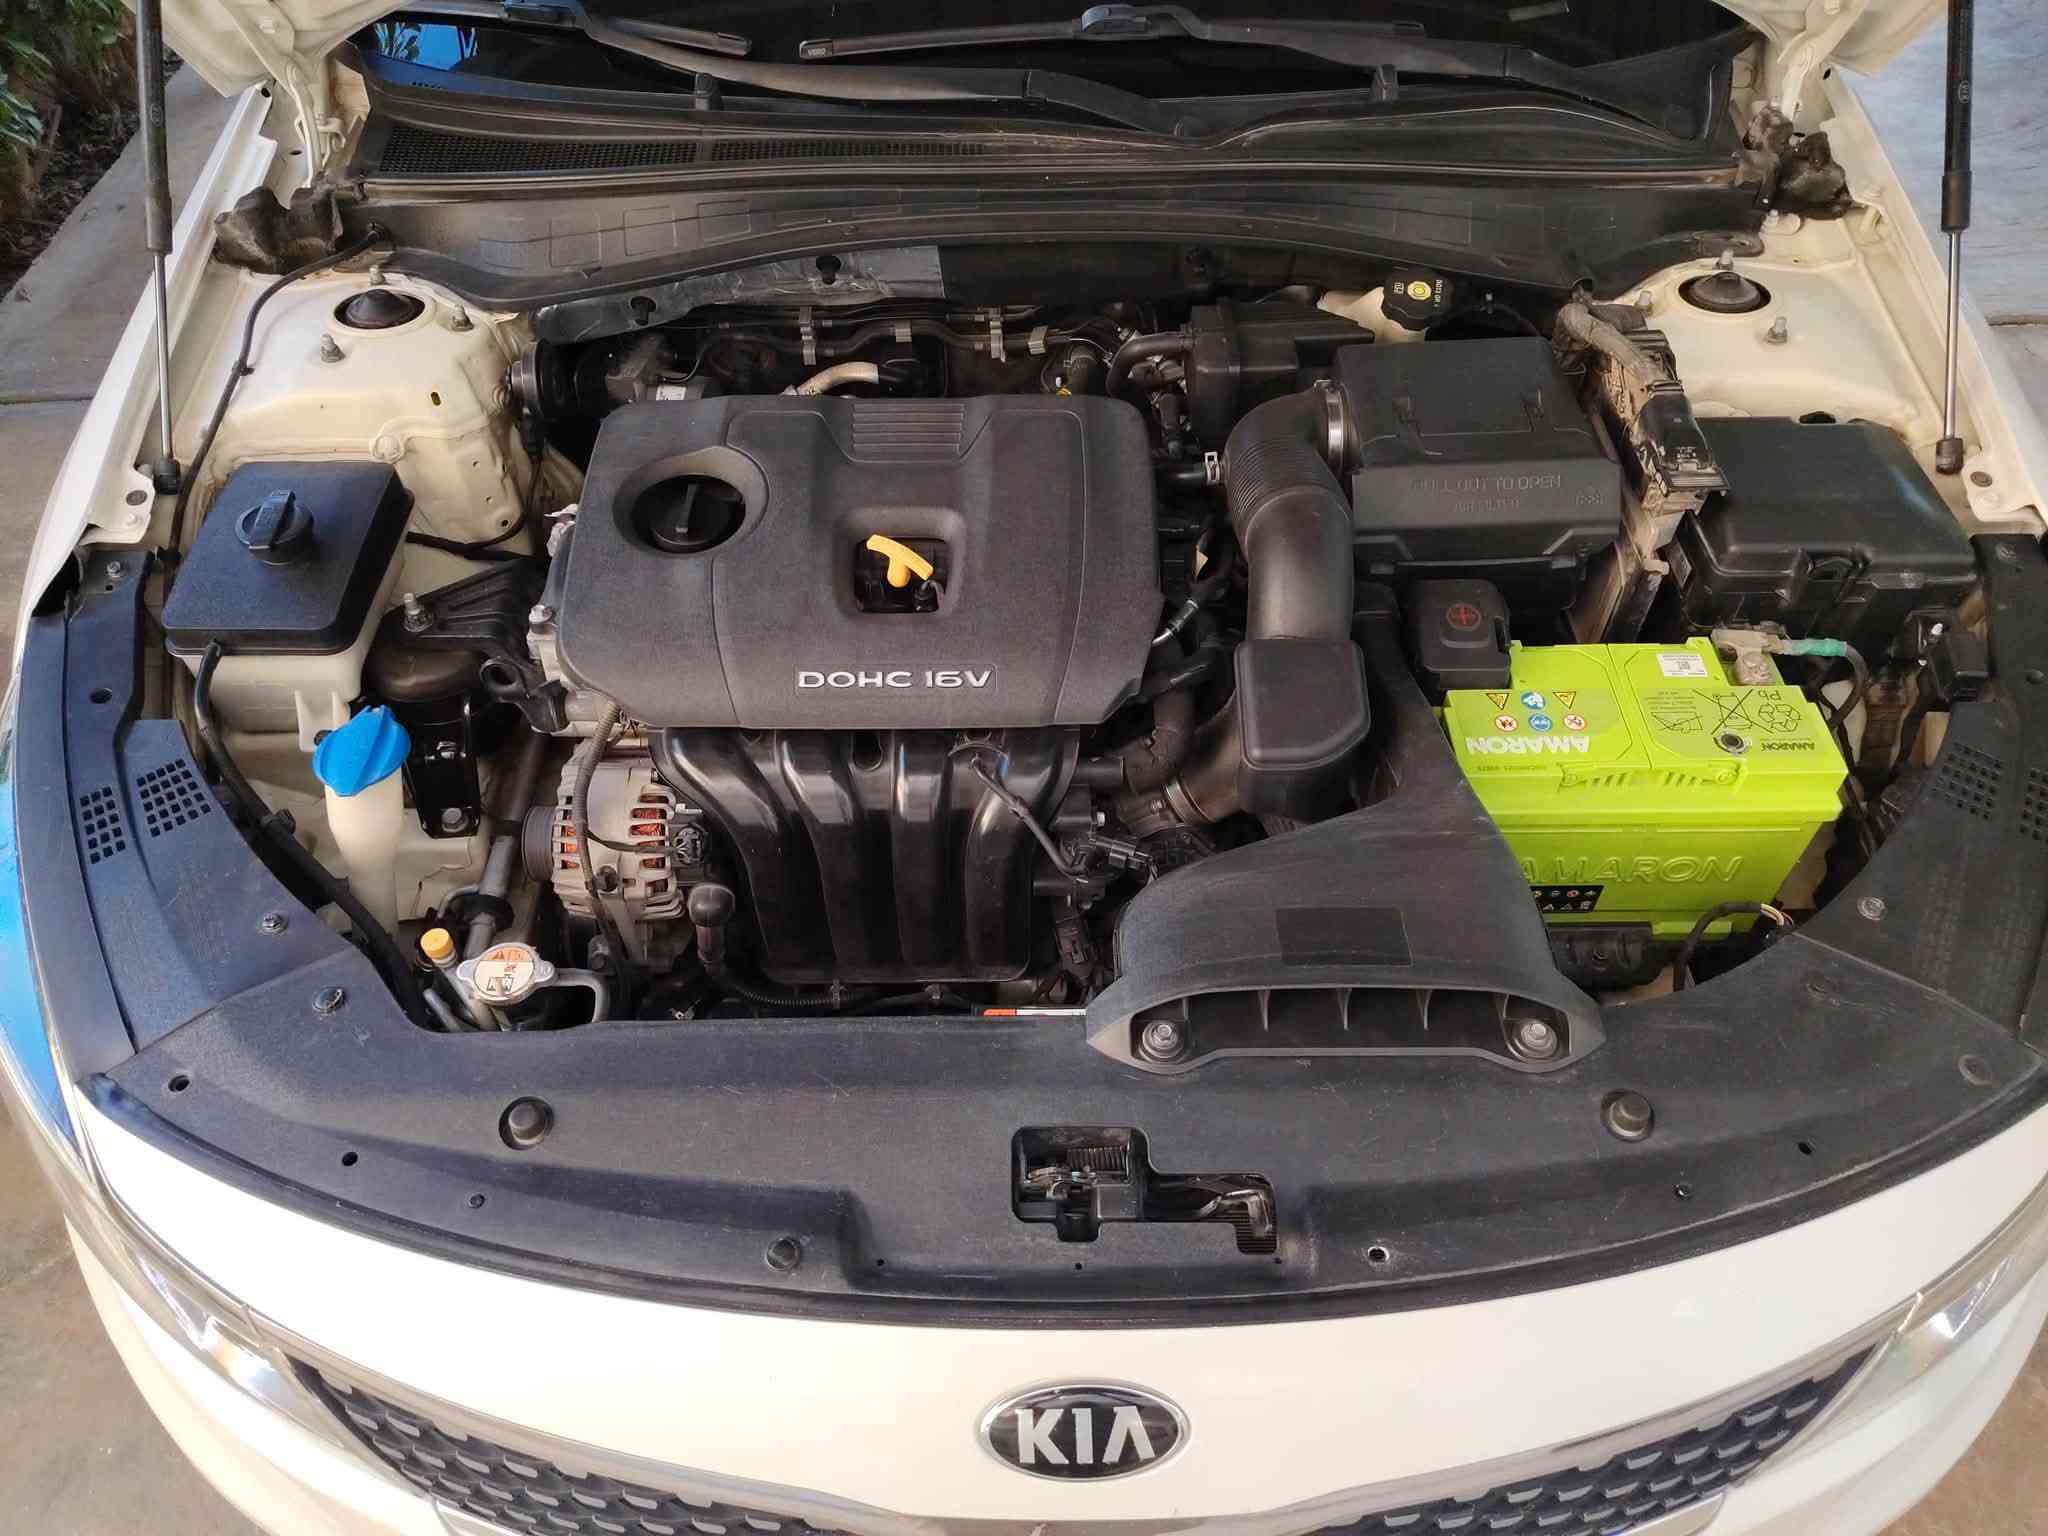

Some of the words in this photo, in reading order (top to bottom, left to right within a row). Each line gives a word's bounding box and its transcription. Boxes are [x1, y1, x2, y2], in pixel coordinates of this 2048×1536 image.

[1496, 475, 1514, 490] TO
[1517, 474, 1561, 490] OPEN
[798, 671, 912, 688] DOHC
[926, 671, 992, 688] 16V
[1757, 690, 1783, 702] Pb
[1466, 736, 1590, 754] AMARON
[1519, 855, 1745, 883] AMARON
[1015, 1406, 1155, 1464] KIA
